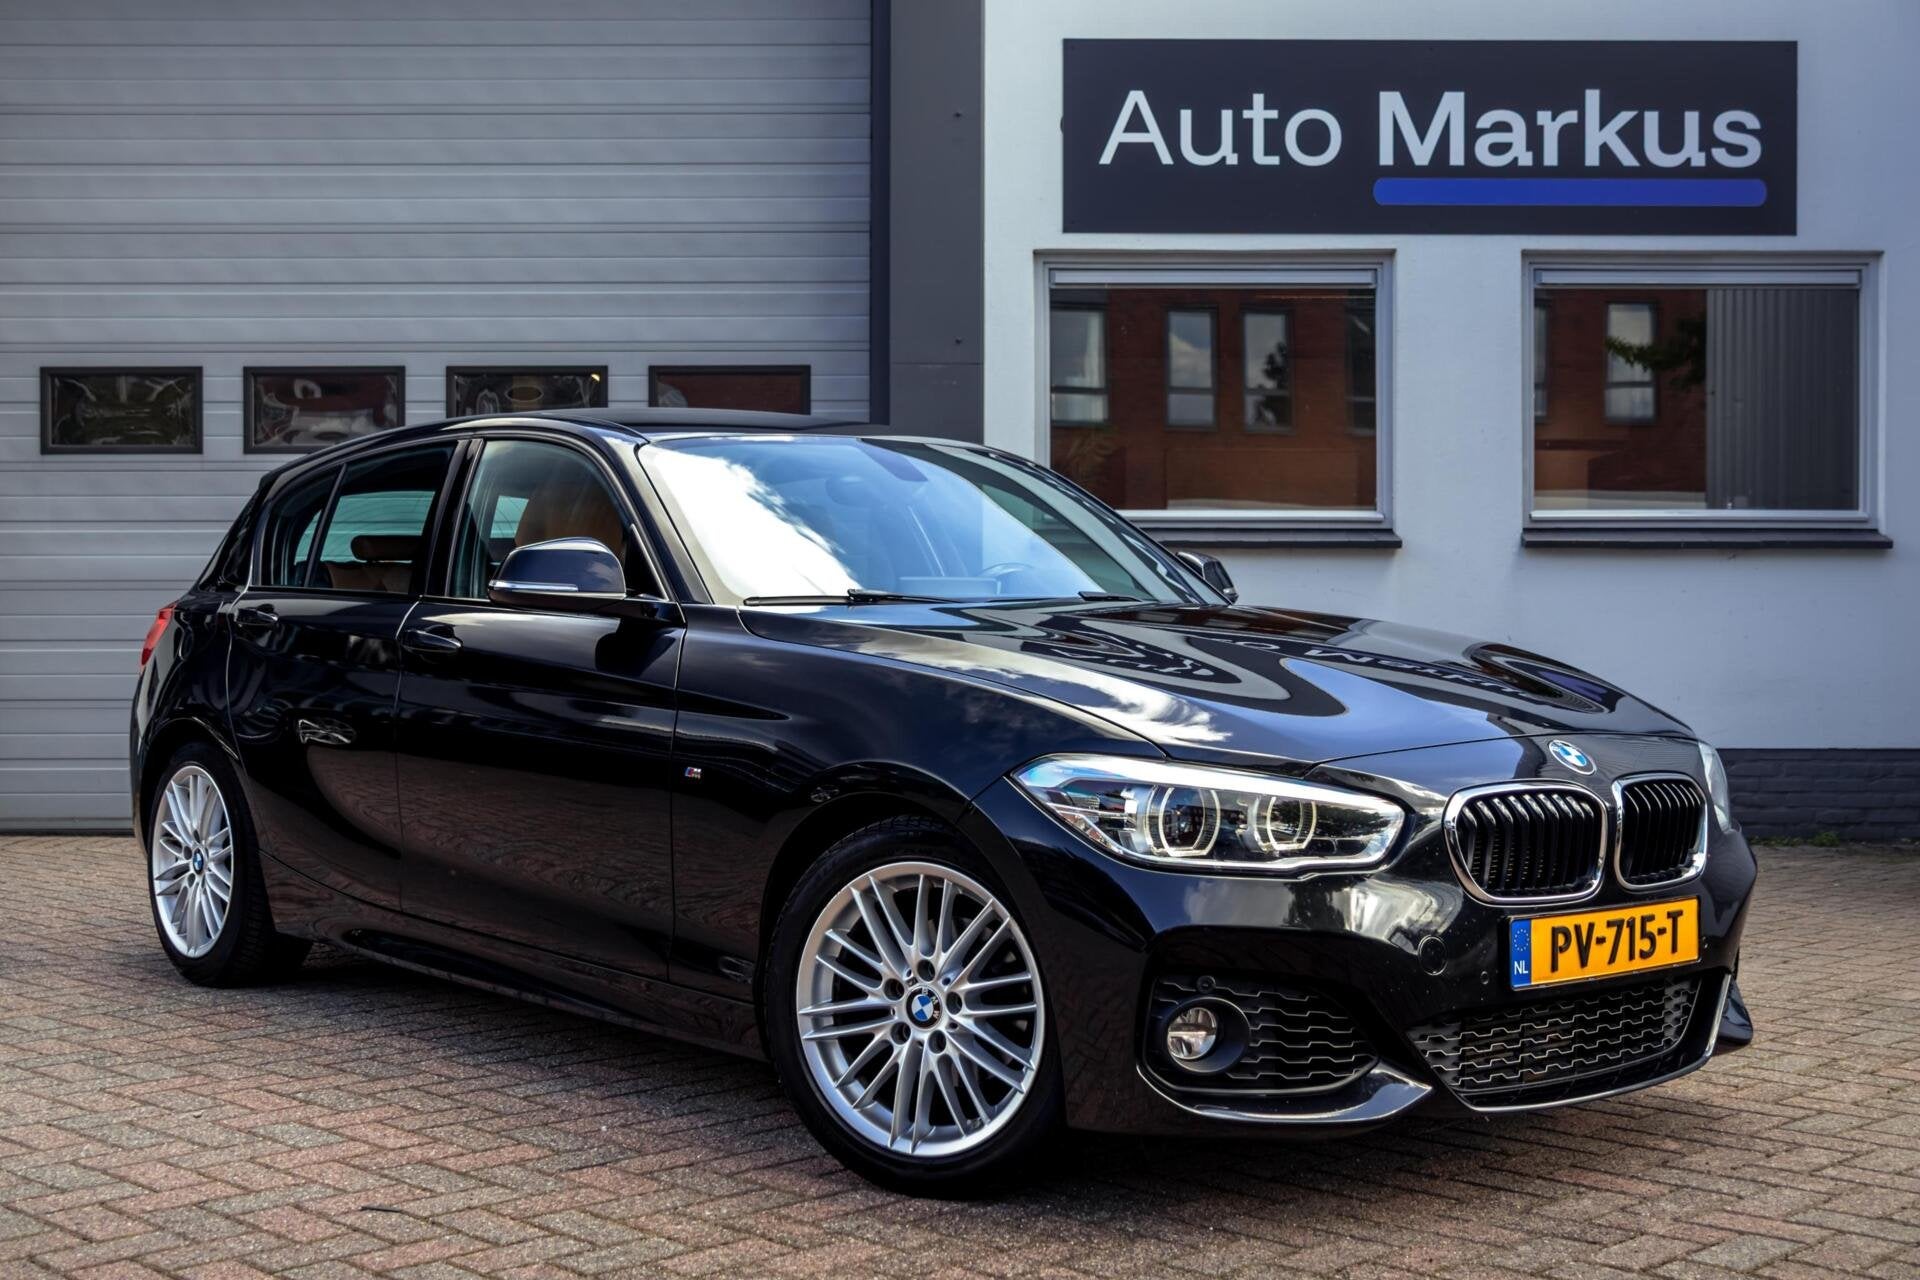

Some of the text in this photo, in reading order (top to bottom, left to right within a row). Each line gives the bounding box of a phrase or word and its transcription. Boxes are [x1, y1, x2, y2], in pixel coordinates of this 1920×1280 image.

[1099, 88, 1763, 169] Auto Markus
[1513, 960, 1529, 976] NL
[1550, 909, 1684, 974] PV-715-T
